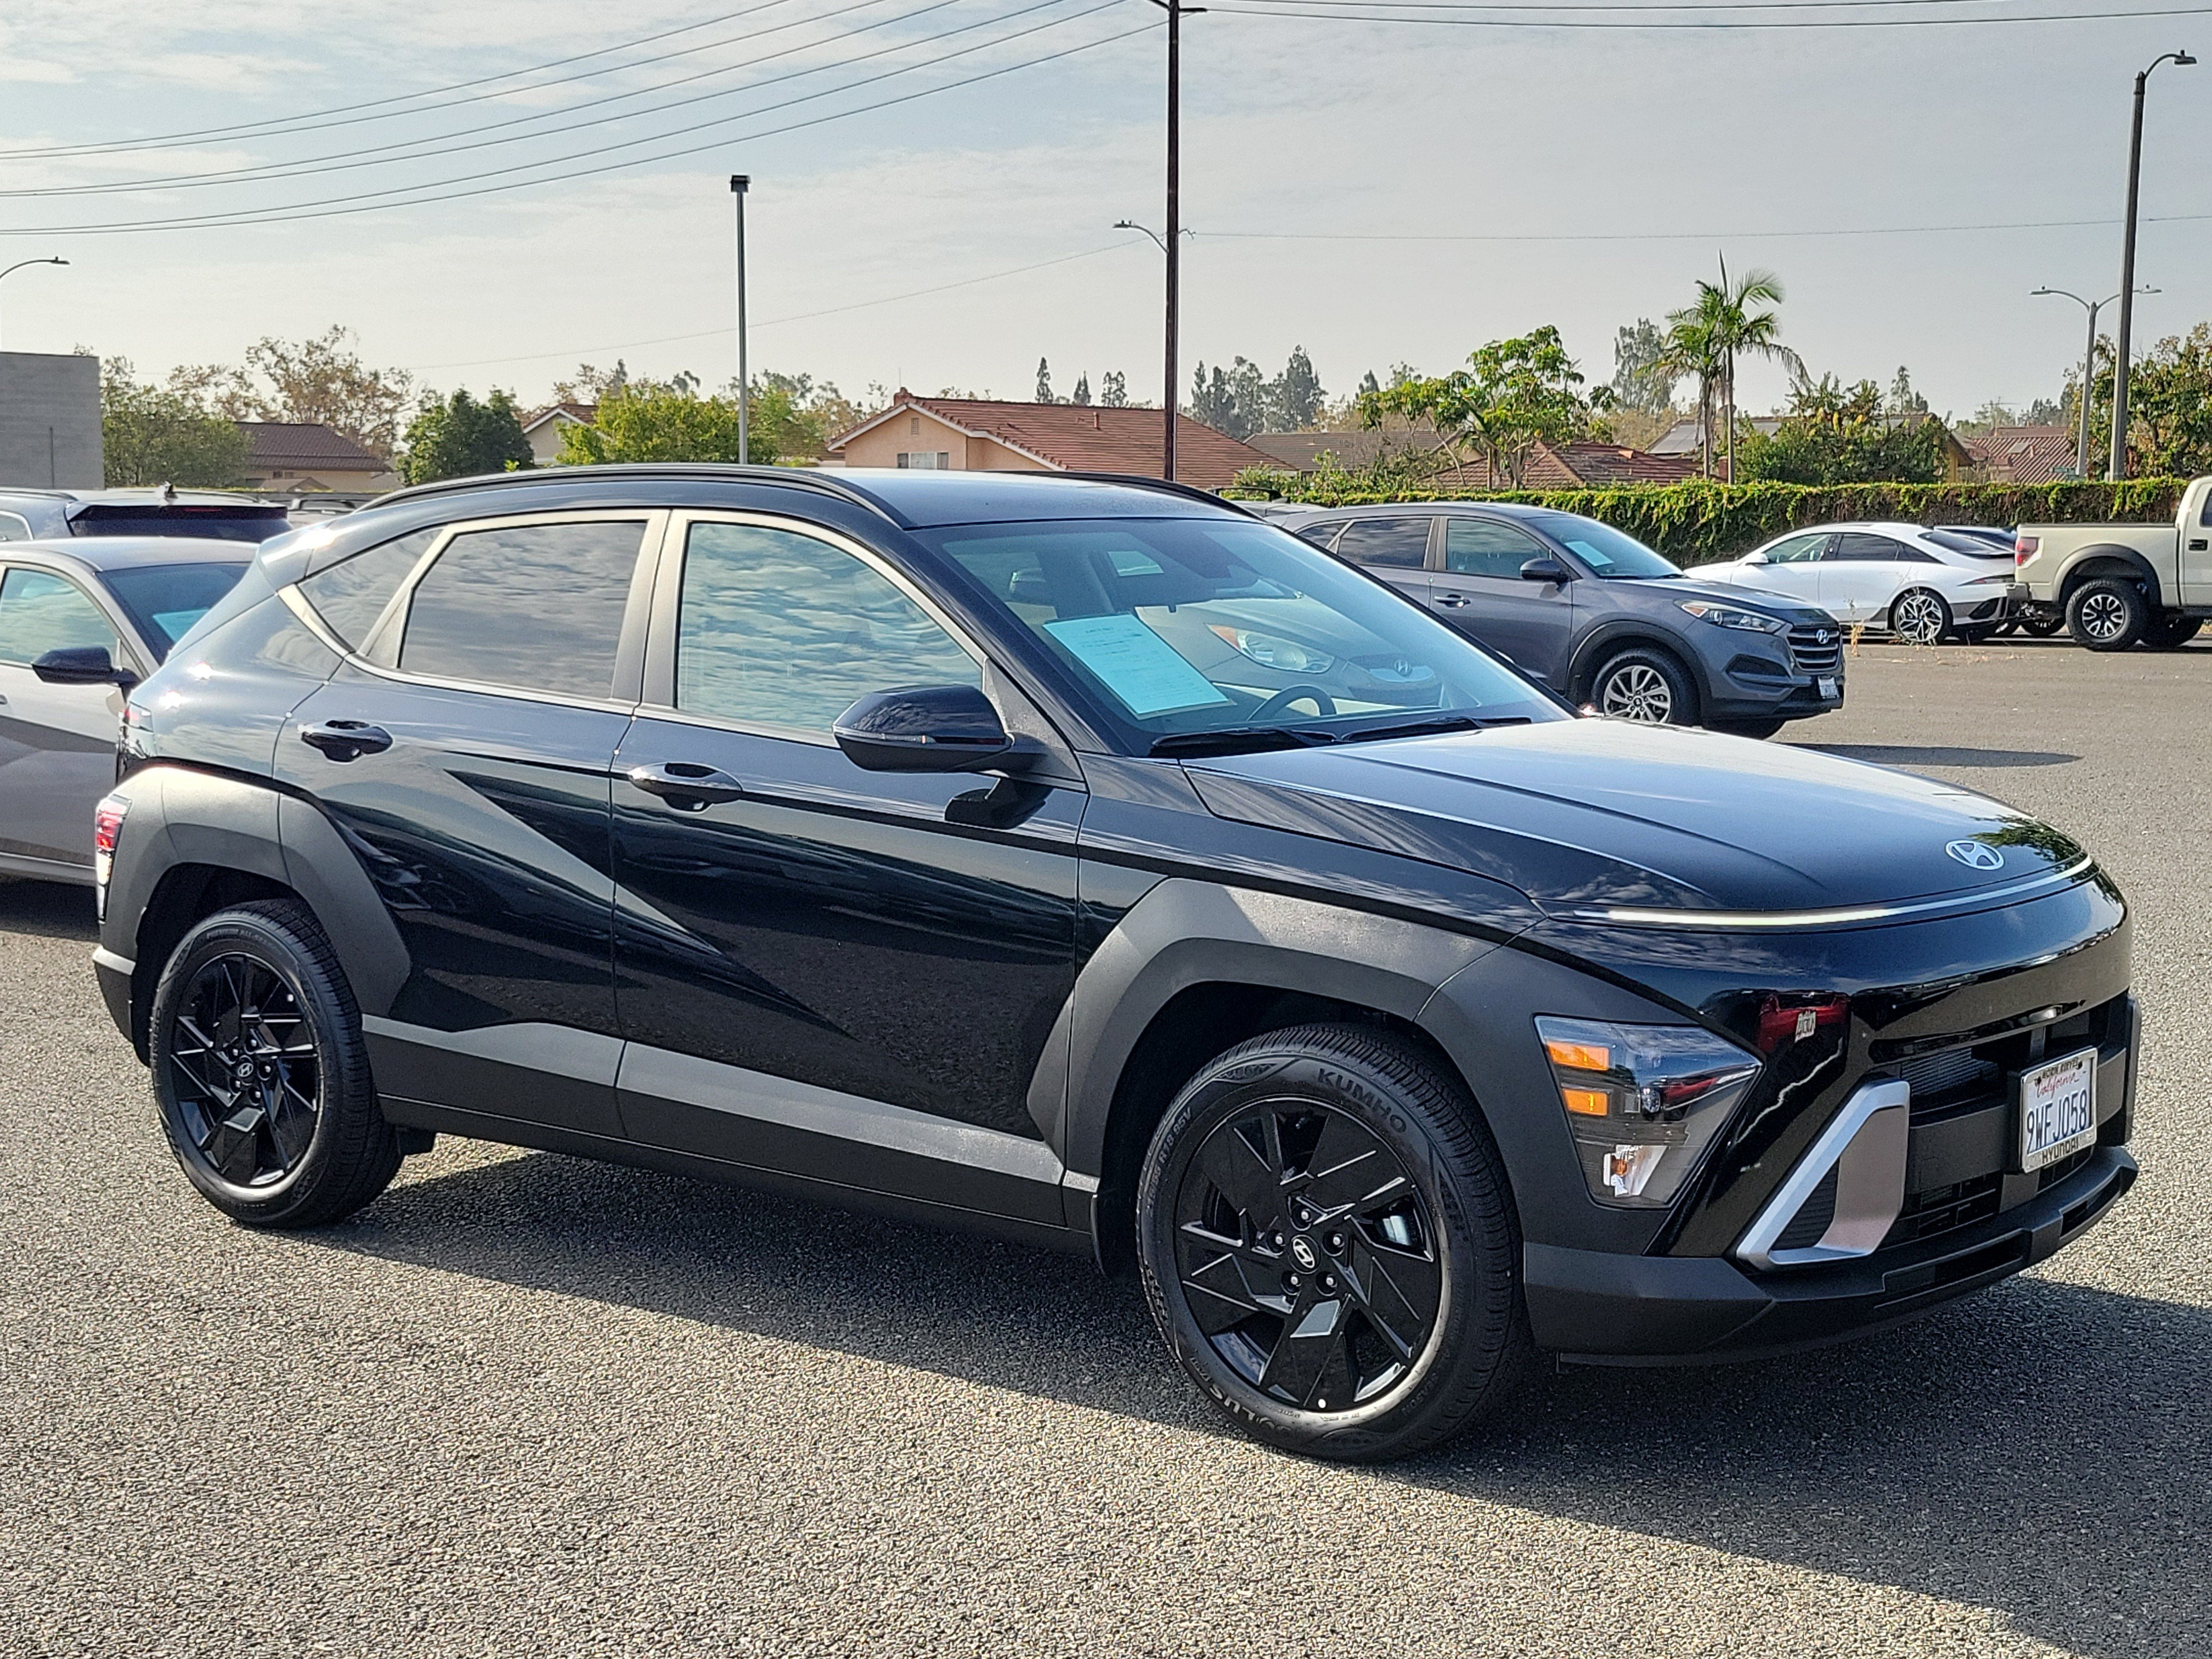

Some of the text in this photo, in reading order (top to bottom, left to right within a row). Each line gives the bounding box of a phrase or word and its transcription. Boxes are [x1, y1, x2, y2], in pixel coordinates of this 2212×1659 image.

[1318, 1068, 1406, 1133] KUMHO
[2027, 1089, 2087, 1154] 9WFJ058
[1158, 1133, 1175, 1164] R18
[2042, 1136, 2079, 1164] HYUNDAI
